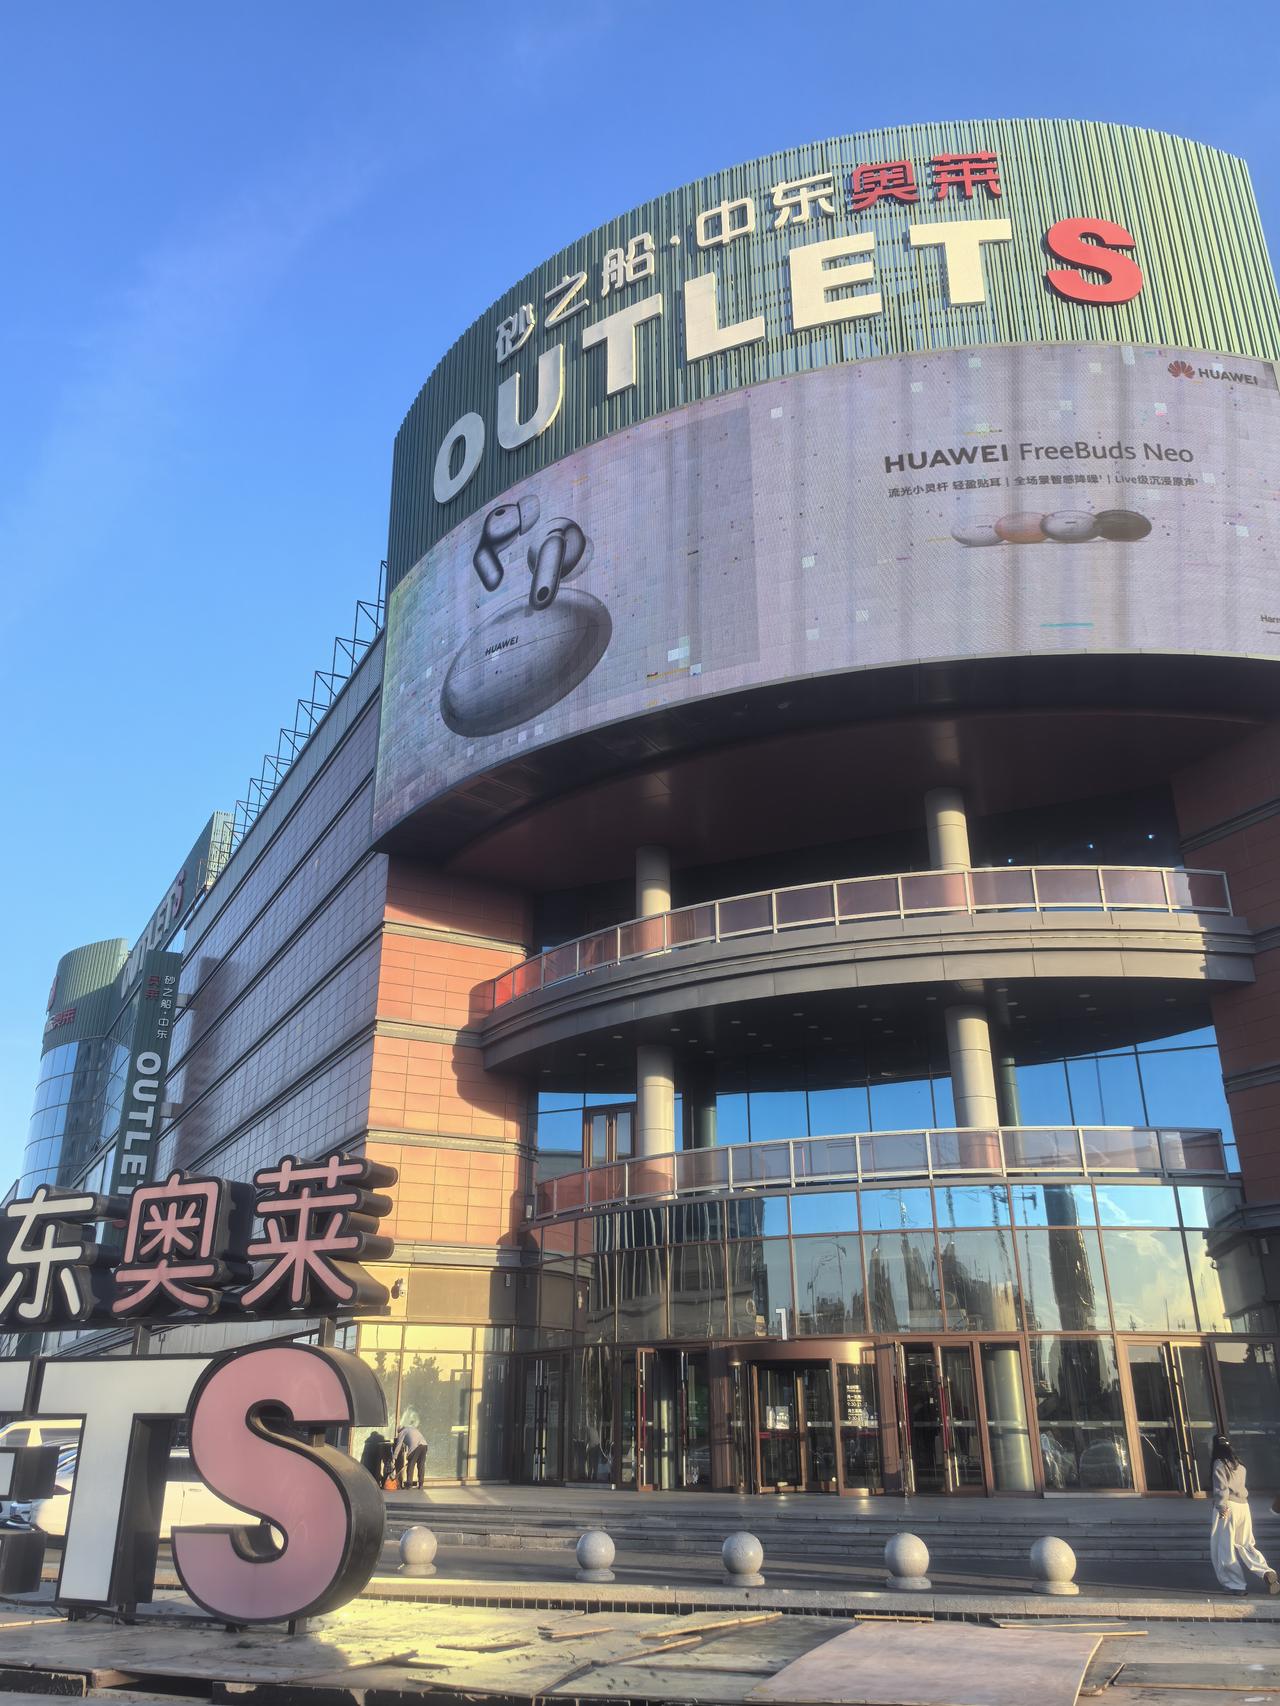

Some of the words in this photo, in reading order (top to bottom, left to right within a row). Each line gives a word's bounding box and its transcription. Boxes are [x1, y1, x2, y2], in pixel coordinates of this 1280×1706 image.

[433, 217, 1144, 504] OUTLETS
[1197, 367, 1259, 386] HUAWEI
[884, 444, 1009, 474] HUAWEI
[1019, 441, 1137, 462] FreeBuds
[1143, 442, 1195, 464] Neo
[484, 635, 519, 657] HUAWEI
[0, 1154, 366, 1319] 东奥莱
[0, 1345, 353, 1620] TS
